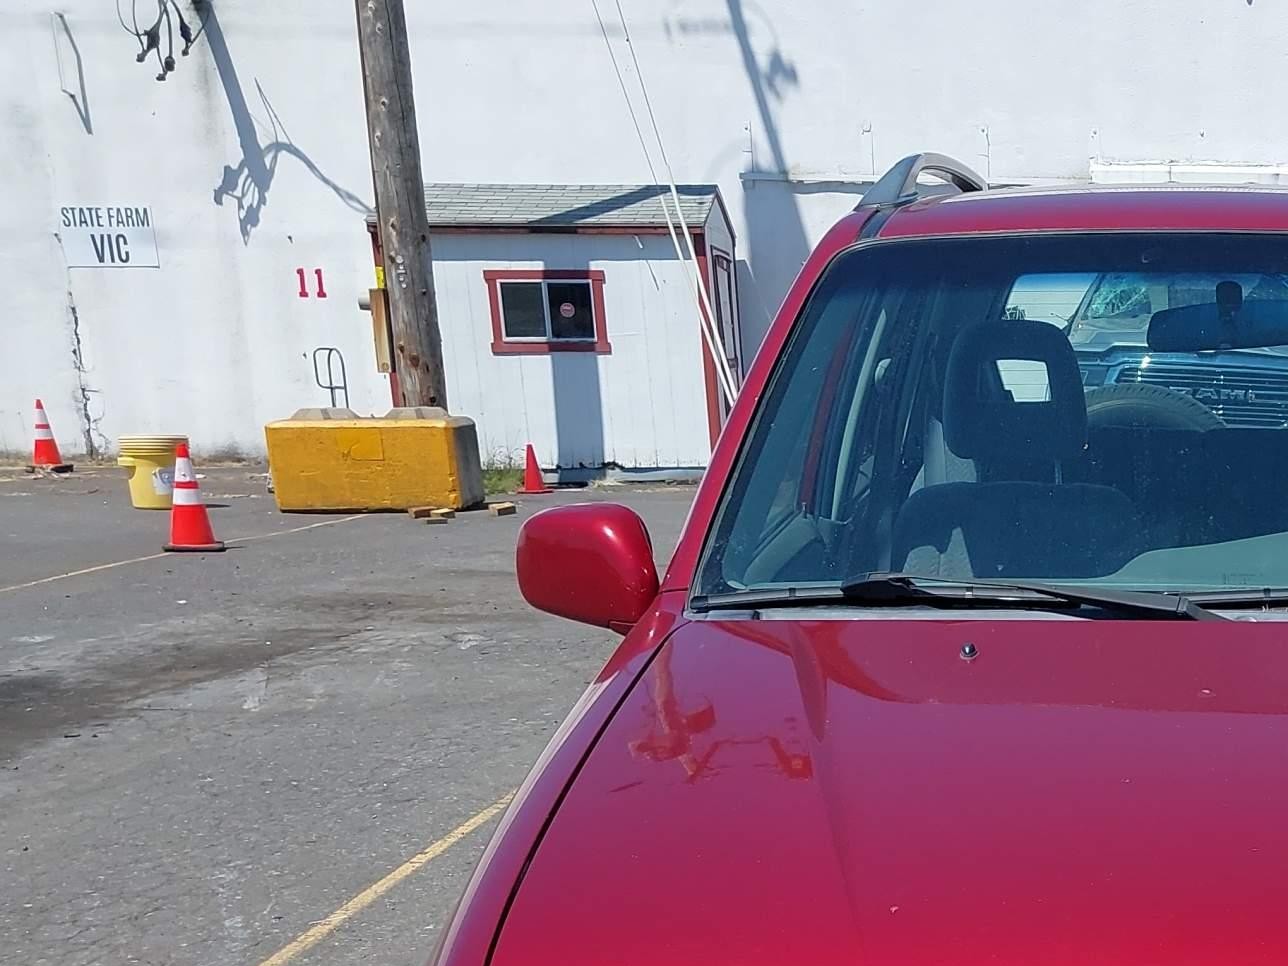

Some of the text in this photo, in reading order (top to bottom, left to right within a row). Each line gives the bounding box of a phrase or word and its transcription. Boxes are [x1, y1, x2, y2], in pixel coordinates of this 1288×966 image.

[61, 207, 151, 228] STATE FARM
[90, 233, 131, 264] VIC
[296, 268, 328, 298] 11
